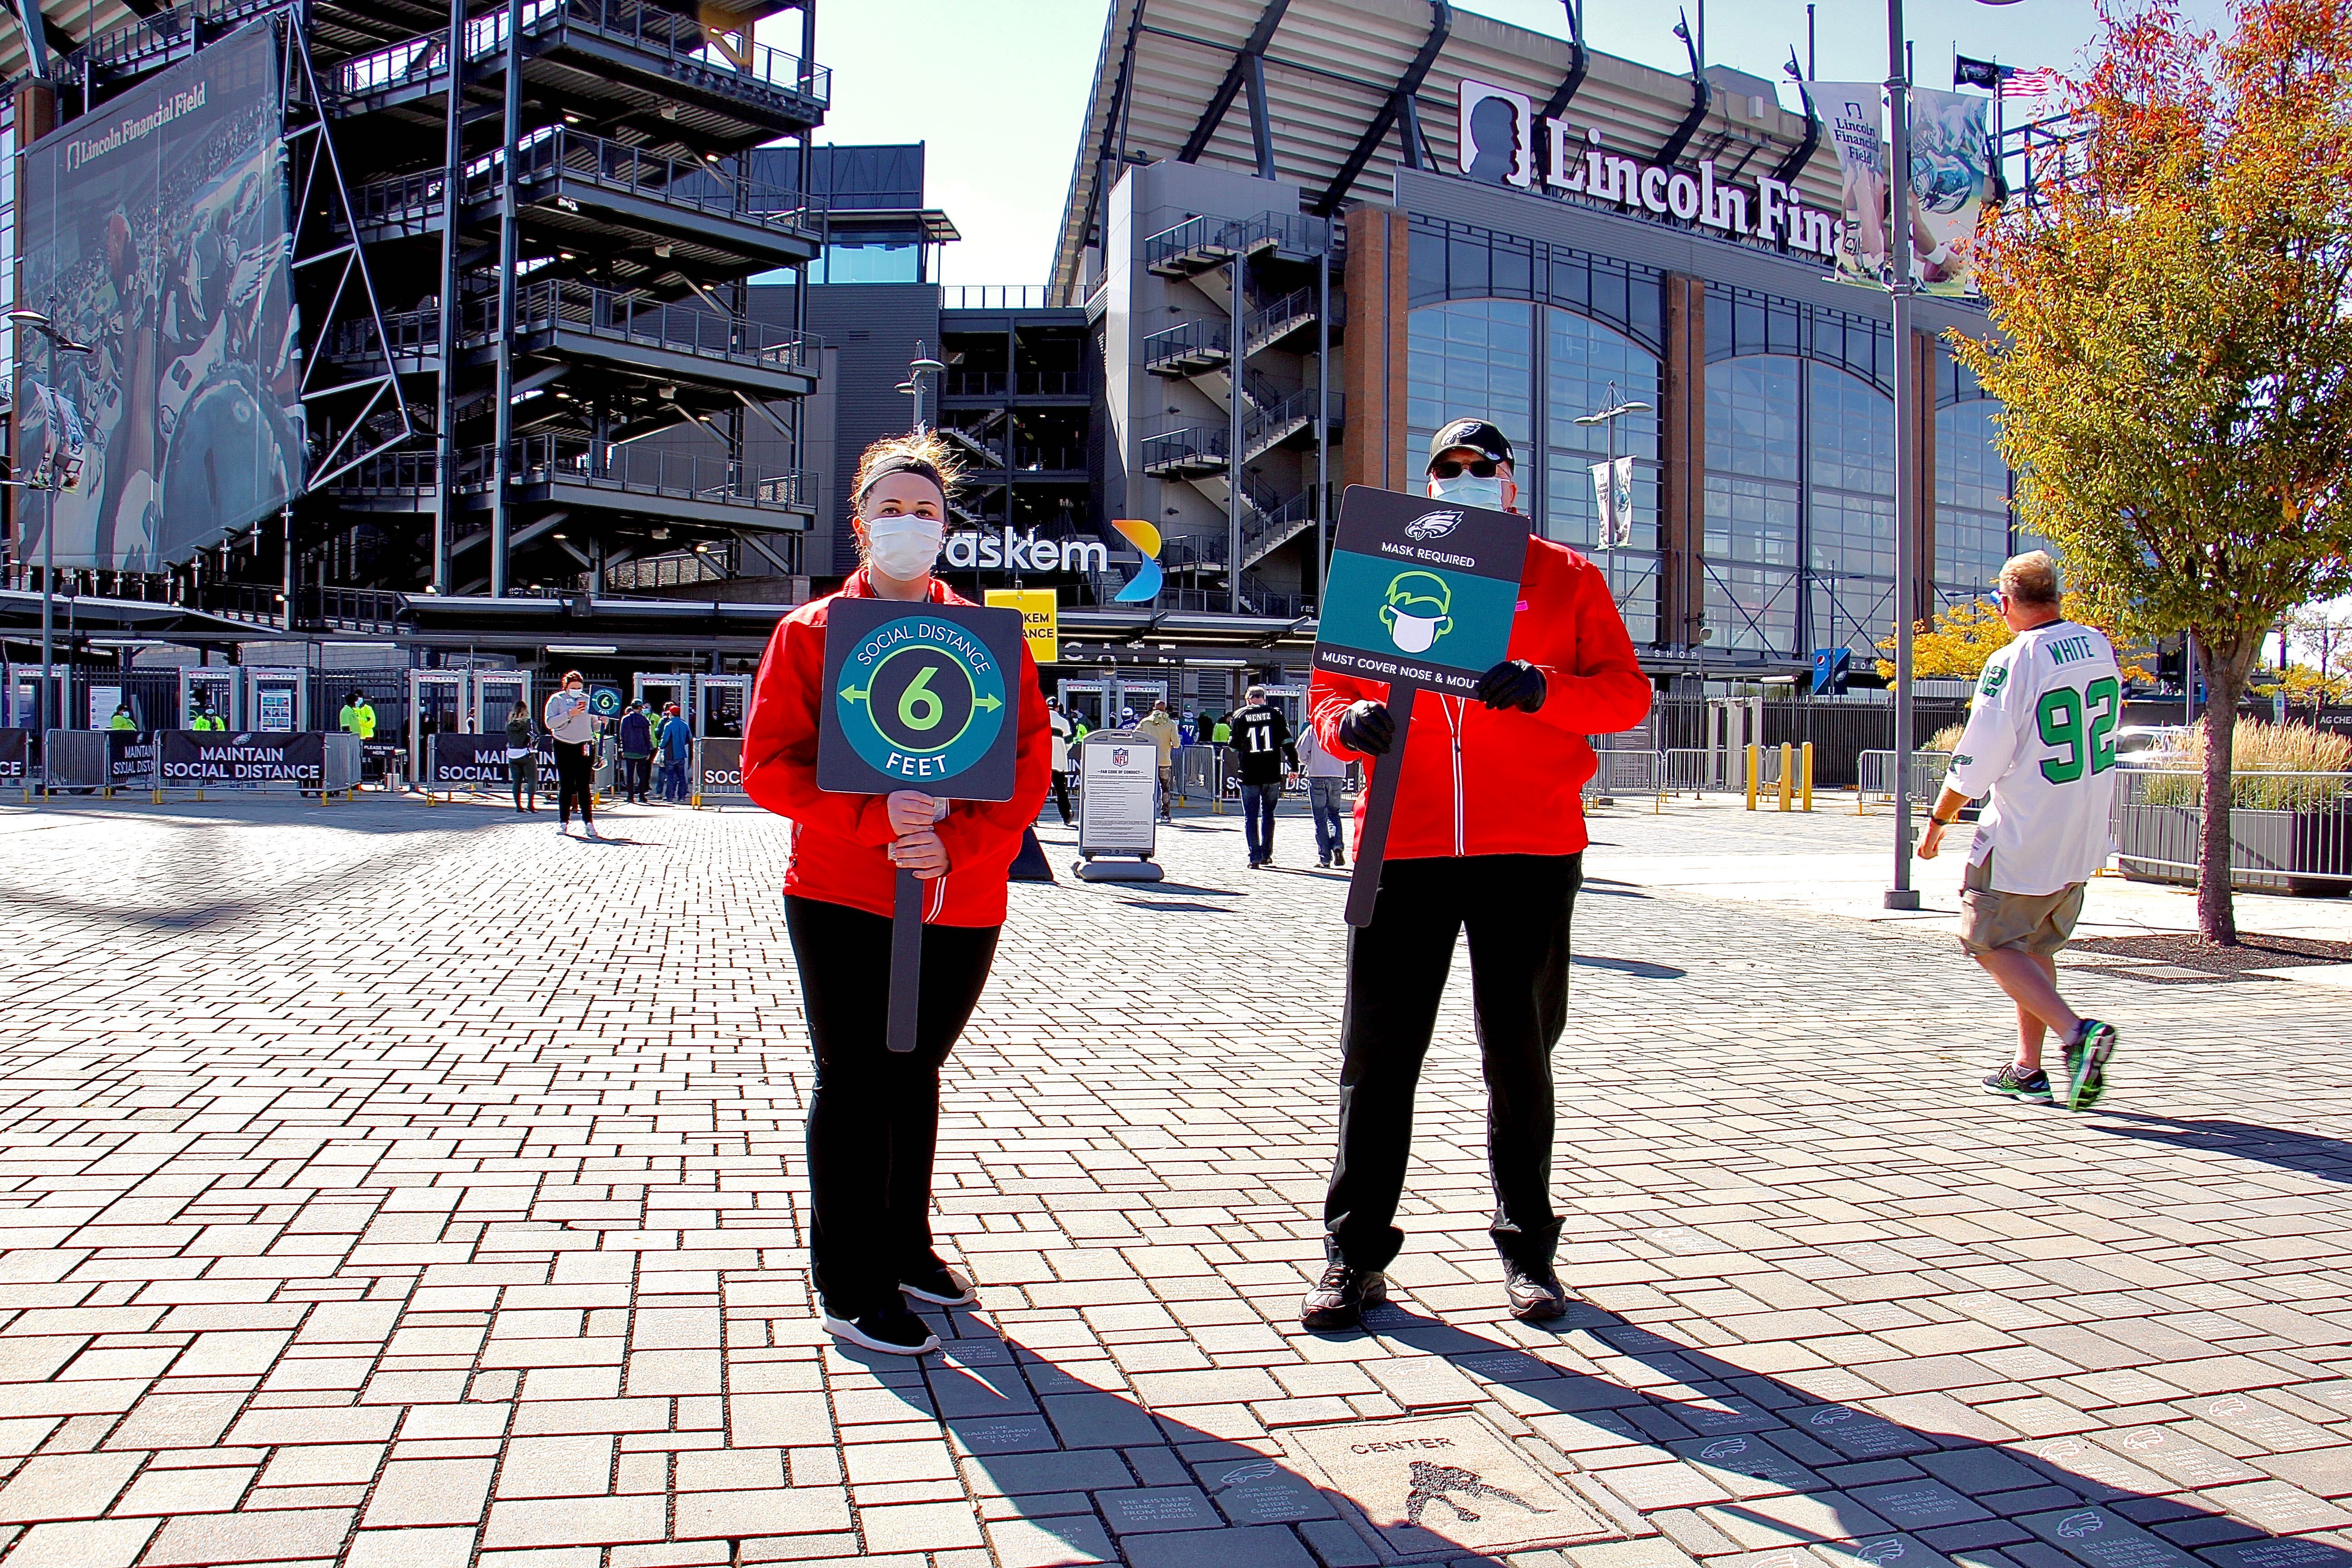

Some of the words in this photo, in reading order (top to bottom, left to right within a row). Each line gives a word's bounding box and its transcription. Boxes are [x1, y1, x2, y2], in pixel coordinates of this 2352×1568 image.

[81, 127, 121, 163] Lincoln
[122, 97, 173, 144] Financial
[174, 81, 206, 118] Field
[1835, 118, 1875, 137] Lincoln
[1833, 129, 1879, 152] Financial
[1849, 146, 1872, 165] Field
[1546, 117, 1749, 234] Lincoln
[946, 526, 1108, 572] askem
[1382, 541, 1414, 557] MASK
[1417, 547, 1475, 568] REQUIRED
[858, 625, 914, 666] SOCIAL
[918, 623, 990, 675] DISTANCE
[1655, 651, 1697, 659] SHOP
[2046, 636, 2095, 666] WHITE
[1322, 651, 1355, 666] MUST
[1357, 658, 1396, 674] COVER
[1400, 666, 1434, 681] NOSE
[1435, 672, 1443, 683] &
[601, 696, 609, 707] 6
[898, 666, 943, 730] 6
[1245, 713, 1271, 721] WENTZ
[2036, 675, 2122, 785] 92
[1247, 725, 1273, 753] 11
[200, 746, 284, 761] MAINTAIN
[1114, 756, 1127, 765] NFL
[113, 761, 135, 775] SOCIAL
[164, 763, 230, 777] SOCIAL
[235, 764, 319, 779] DISTANCE
[886, 752, 946, 776] FEET
[439, 765, 503, 780] SOCIAL
[1351, 1437, 1456, 1455] CENTER
[1237, 1489, 1298, 1498] GRANDSON
[1877, 1494, 1909, 1502] HAPPY
[1892, 1495, 1938, 1505] BIRTHDAY
[2087, 1547, 2124, 1555] TEXAS
[2124, 1543, 2156, 1551] BORN
[2103, 1552, 2136, 1560] PHILLY
[2243, 1553, 2283, 1563] ALWAYS
[2282, 1546, 2337, 1557] TOGETHER
[2256, 1544, 2296, 1553] EAGLES
[2107, 1558, 2140, 1568] BLEED
[2141, 1554, 2177, 1562] GREEN
[2290, 1554, 2338, 1564] FOREVER
